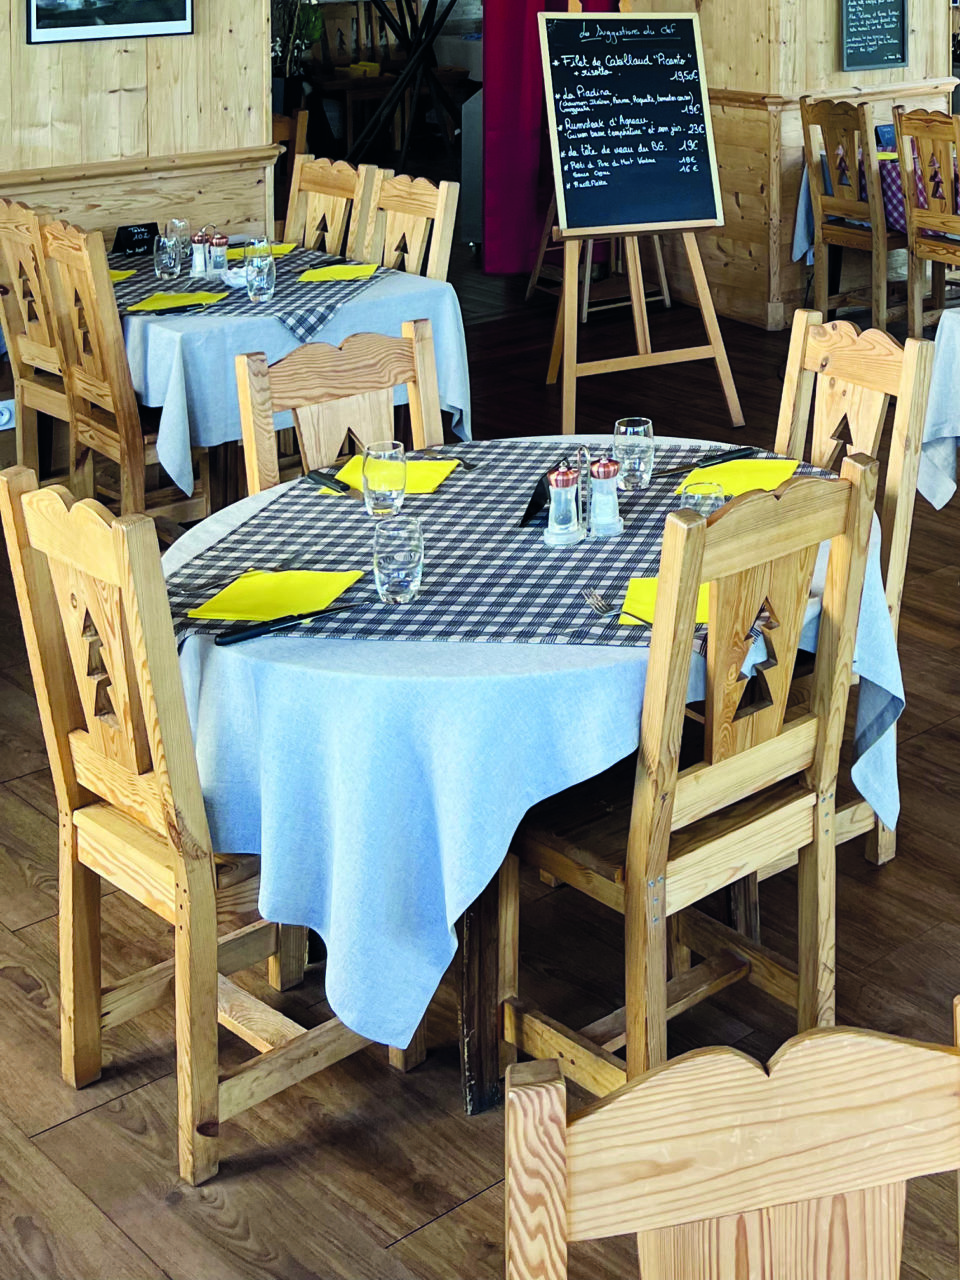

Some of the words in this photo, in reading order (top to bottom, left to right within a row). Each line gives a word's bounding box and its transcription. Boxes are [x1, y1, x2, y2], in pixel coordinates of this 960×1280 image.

[643, 25, 655, 35] du
[560, 55, 590, 67] Filet
[592, 56, 601, 66] de
[605, 53, 653, 67] Cabillaud
[562, 87, 576, 99] La
[568, 145, 580, 156] La
[581, 144, 598, 156] tête
[601, 144, 611, 154] de
[614, 146, 634, 154] veau
[638, 143, 649, 153] du
